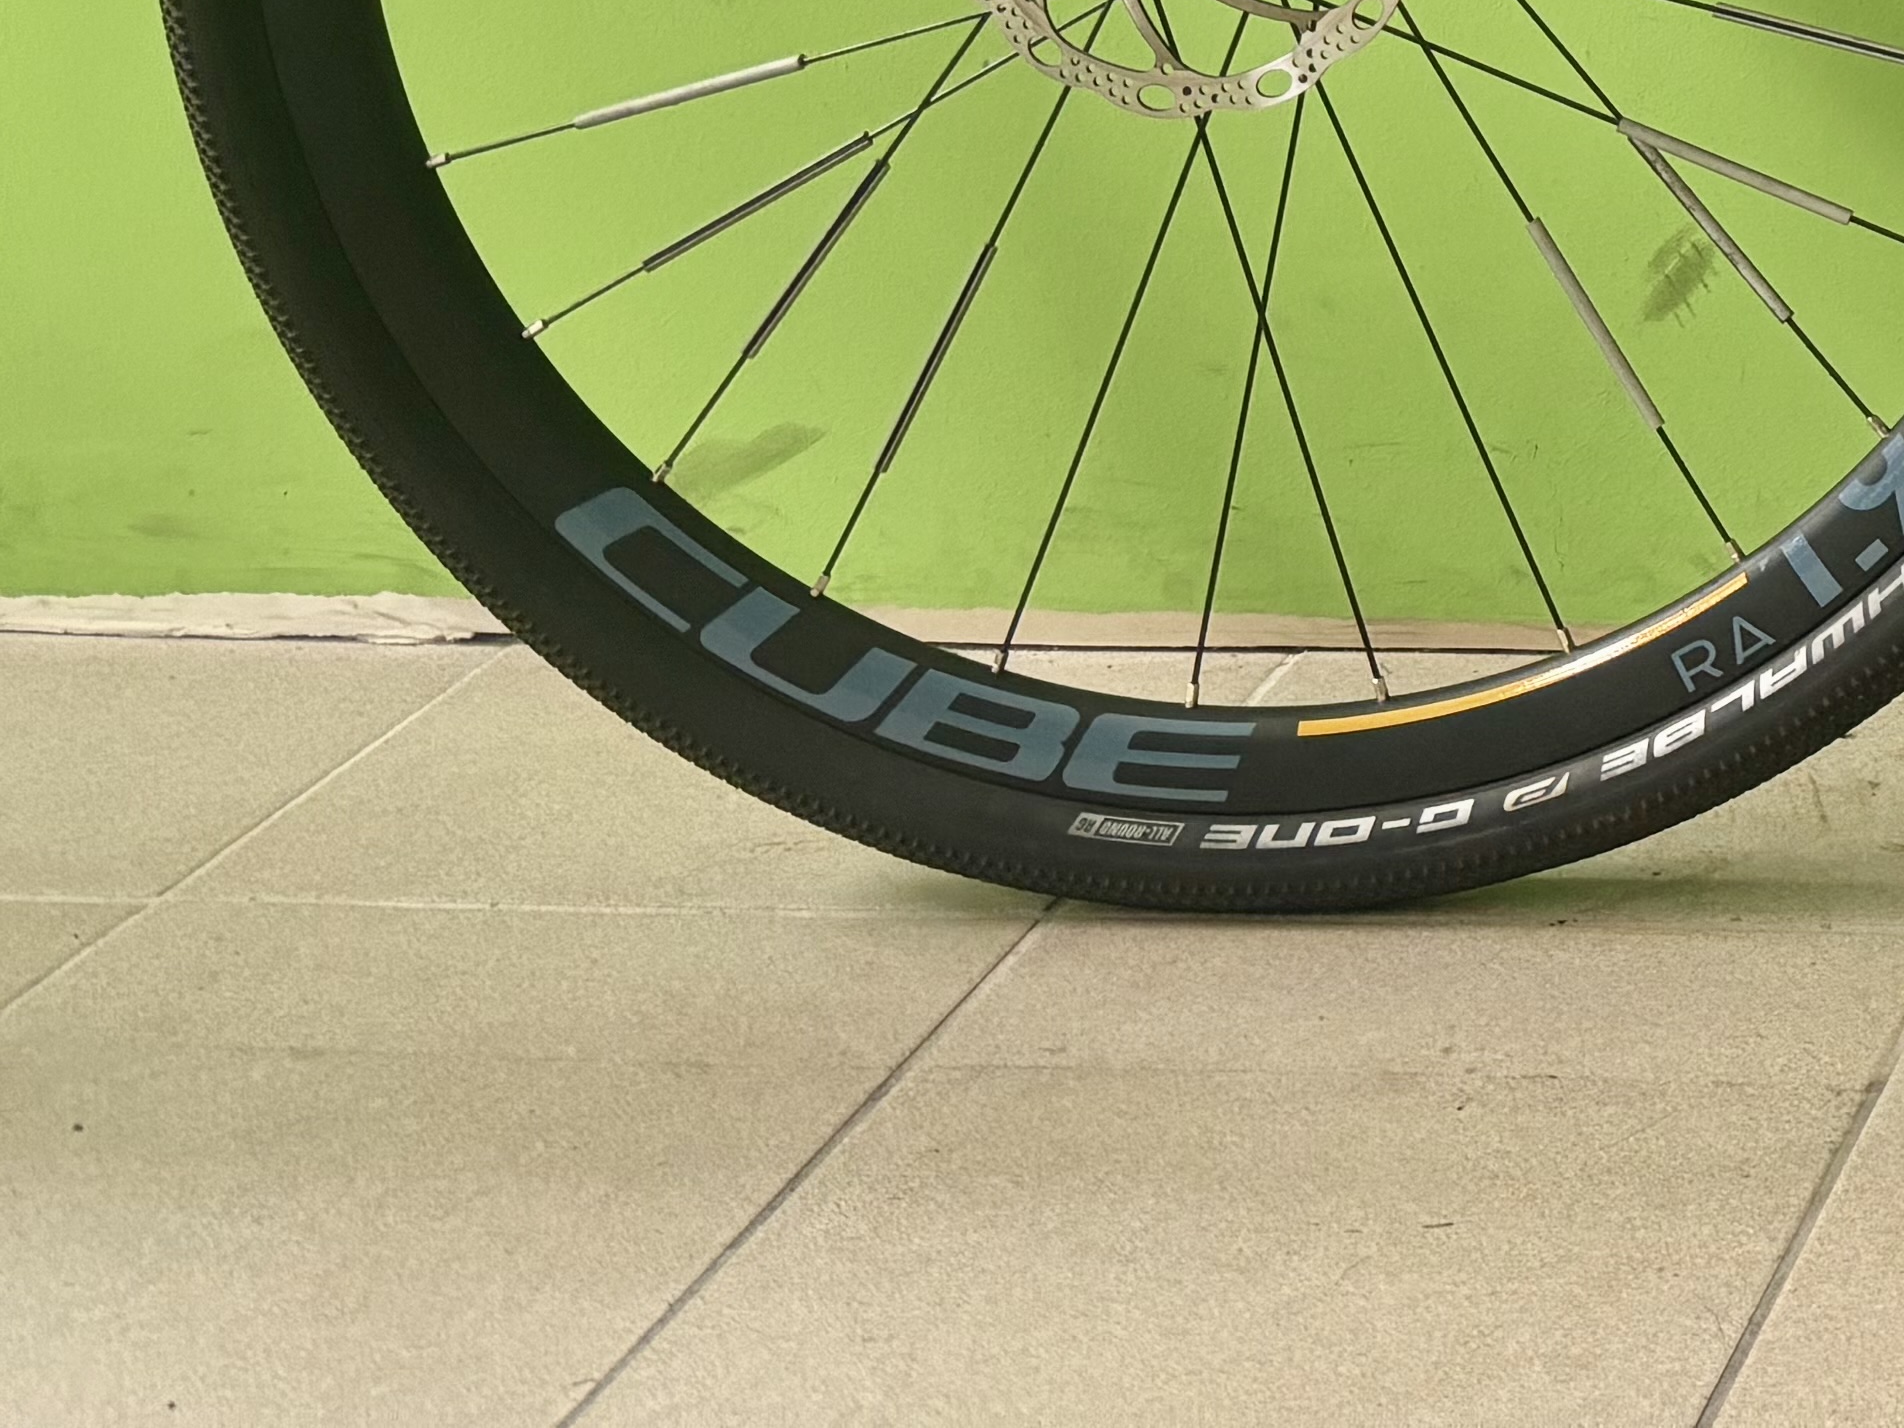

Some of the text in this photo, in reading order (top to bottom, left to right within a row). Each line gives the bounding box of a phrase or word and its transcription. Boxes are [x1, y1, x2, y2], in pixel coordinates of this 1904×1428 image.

[554, 486, 1258, 803] CUBE
[1670, 615, 1777, 694] RA
[1100, 819, 1176, 843] ALL-ROUND
[1200, 797, 1475, 850] G-ONE
